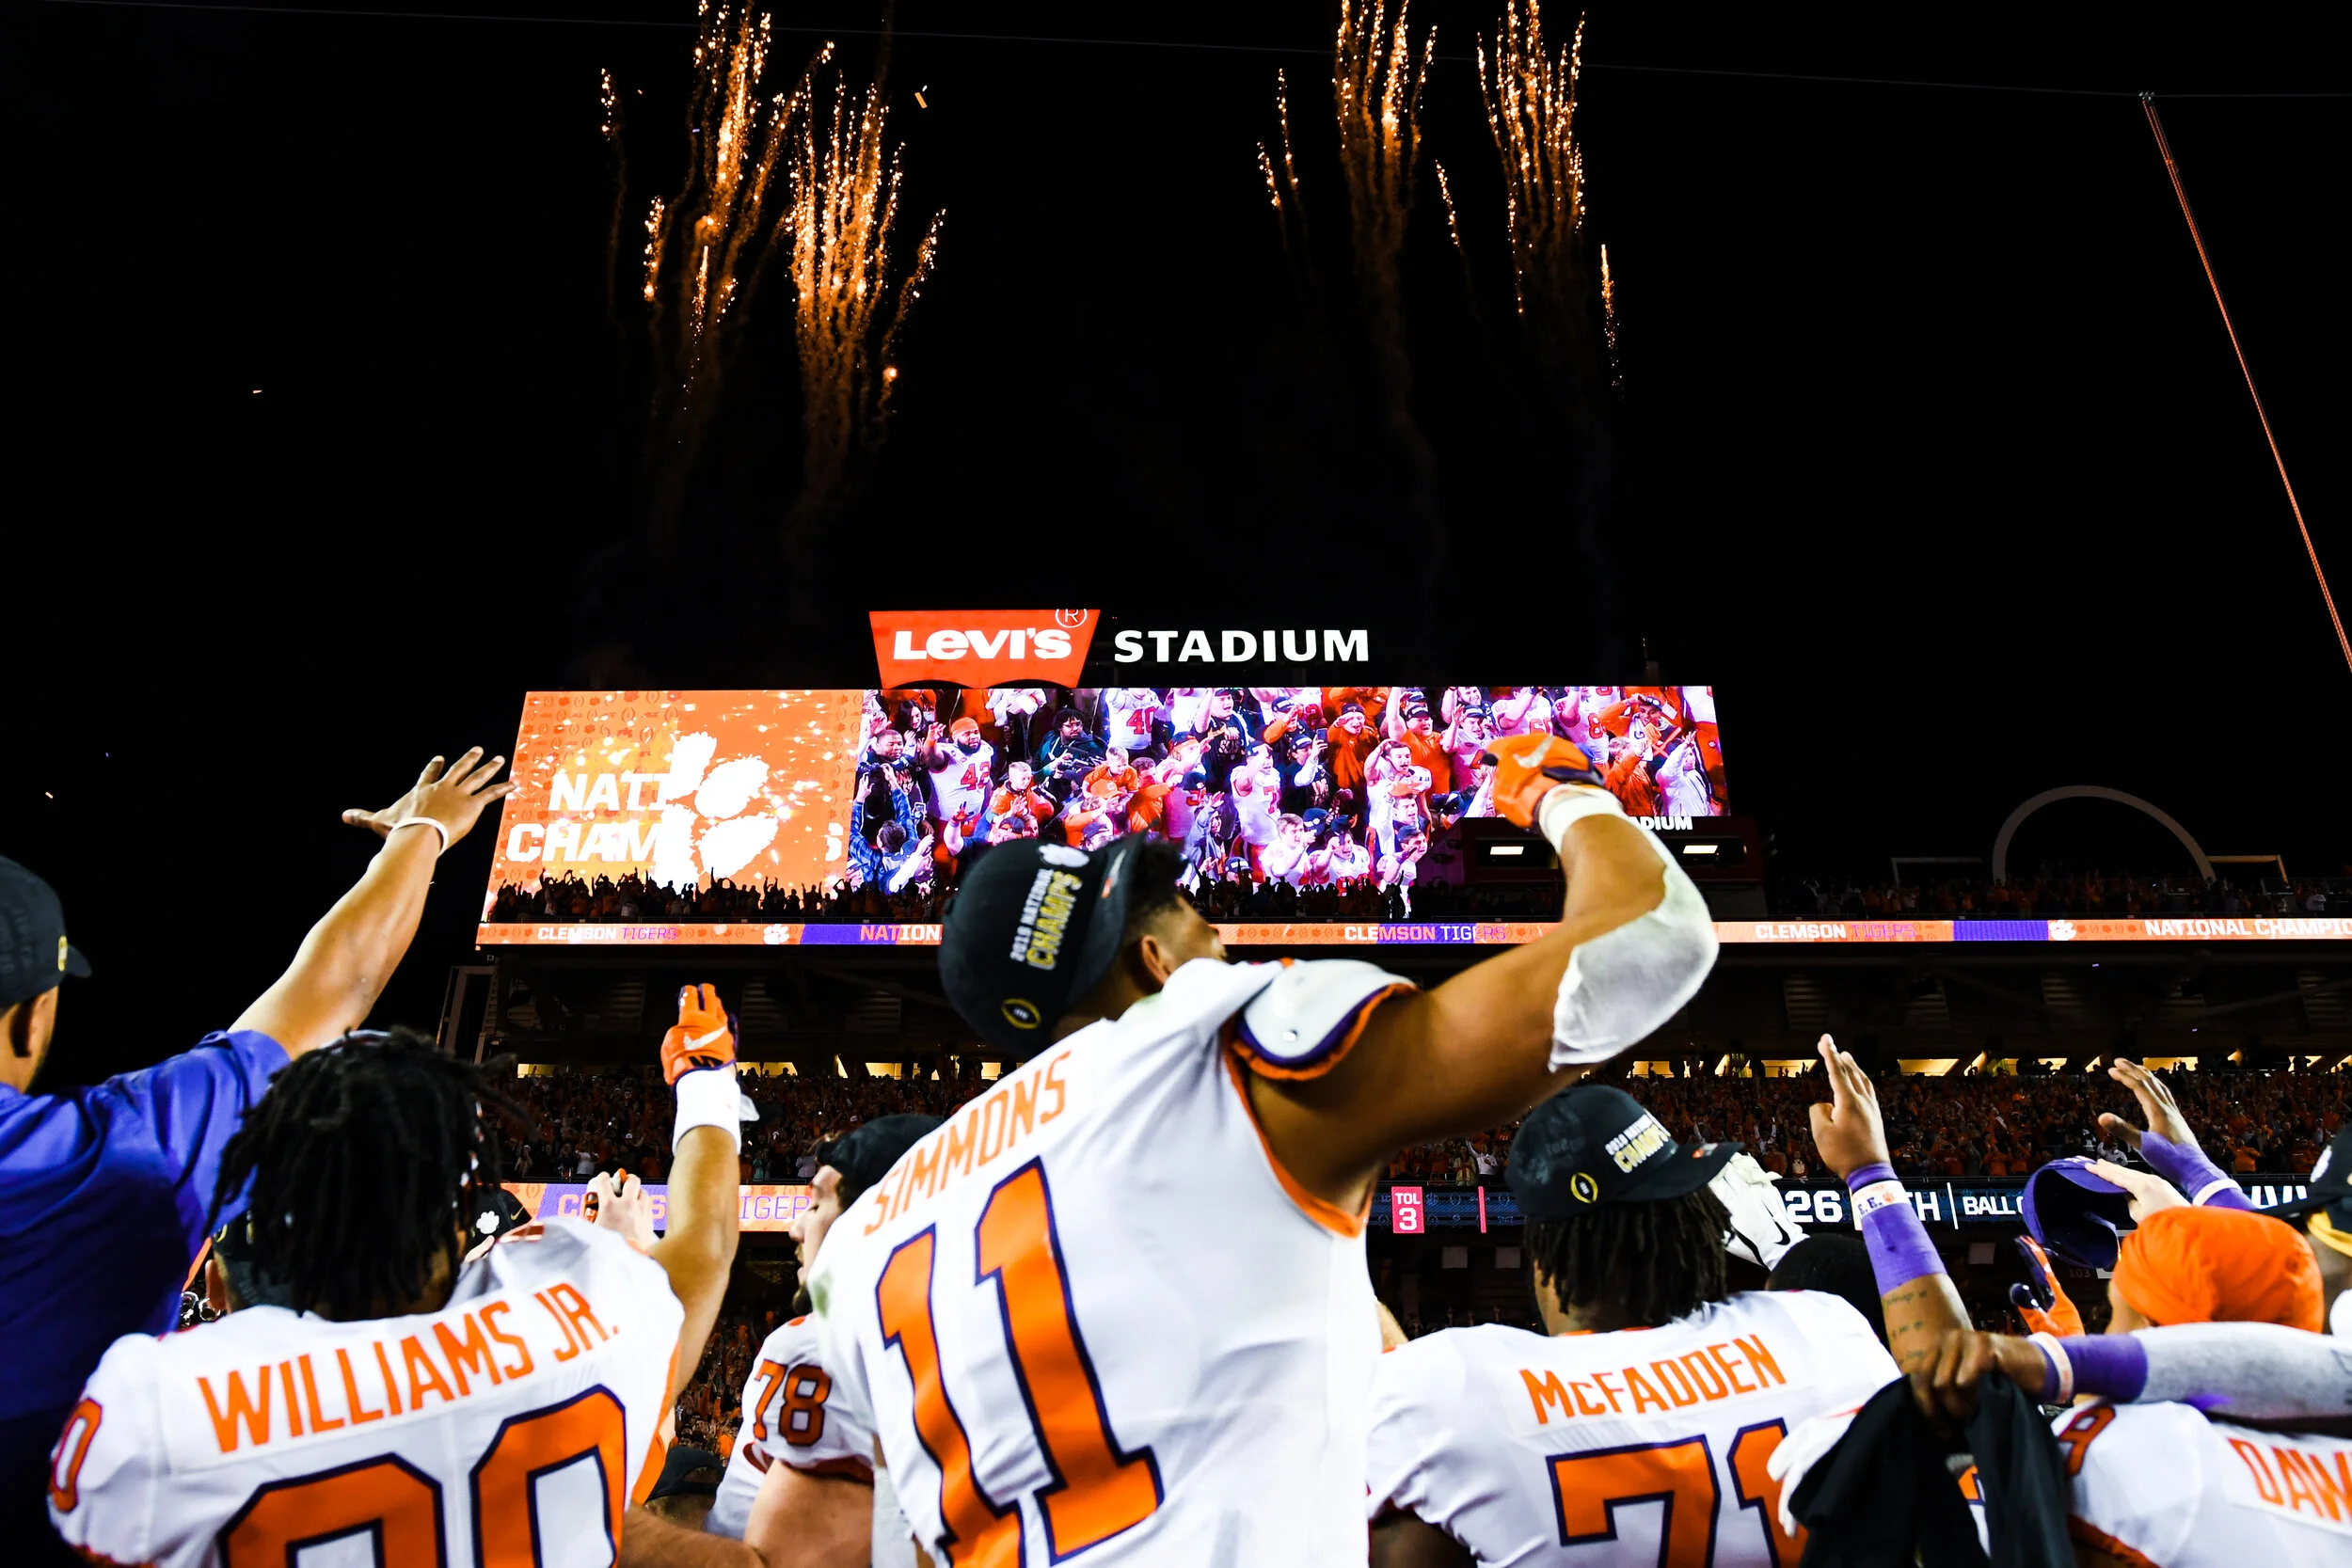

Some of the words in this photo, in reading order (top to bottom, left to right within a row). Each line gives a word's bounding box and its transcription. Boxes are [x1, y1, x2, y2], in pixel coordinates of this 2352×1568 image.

[1114, 629, 1370, 662] STADIUM
[537, 927, 617, 941] CLEMSON
[621, 927, 677, 941] TIGERS
[860, 925, 943, 942] NATION
[1343, 925, 1435, 941] CLEMSON
[1439, 925, 1505, 941] TIGERS
[1755, 924, 1847, 940] CLEMSON
[1851, 923, 1916, 939] TIGERS
[2144, 919, 2252, 937] NATIONAL
[864, 1050, 1072, 1236] SIMMONS
[1395, 1193, 1421, 1205] TOL
[1785, 1190, 1843, 1223] 26
[1963, 1196, 2015, 1215] BALL
[1398, 1207, 1418, 1231] 3
[198, 1300, 534, 1454] WILLIAMS
[532, 1282, 620, 1363] JR.
[875, 1154, 1165, 1568] 11
[1519, 1333, 1788, 1426] McFADDEN
[753, 1358, 833, 1448] 78
